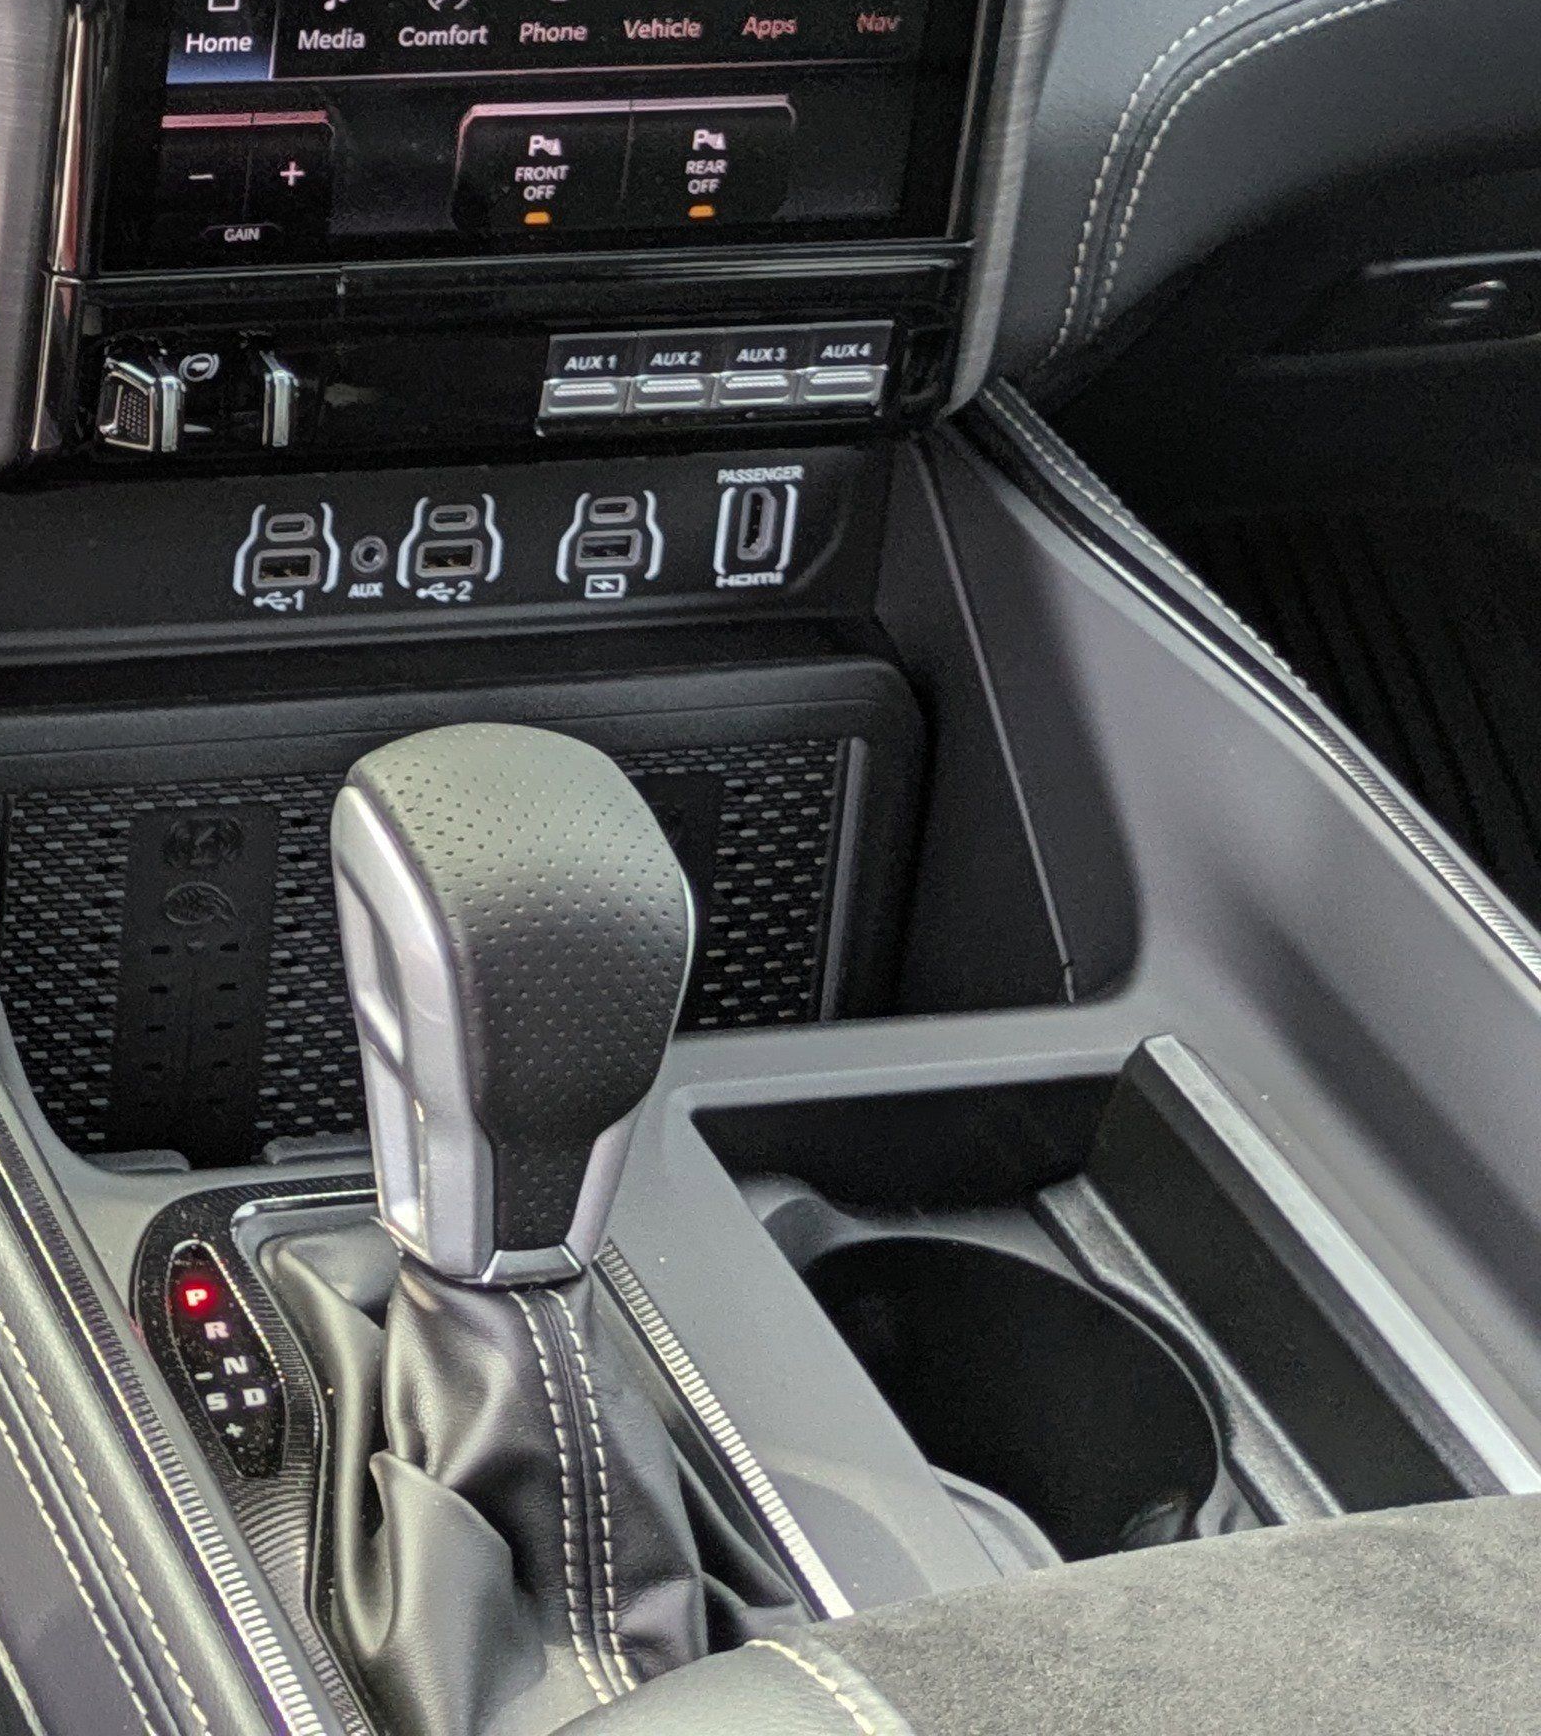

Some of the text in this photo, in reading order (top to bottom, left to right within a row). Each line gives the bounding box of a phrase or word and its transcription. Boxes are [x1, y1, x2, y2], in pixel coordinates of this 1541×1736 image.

[185, 33, 253, 54] Home
[297, 27, 366, 51] Media
[398, 24, 490, 48] Comfort
[519, 21, 589, 44] Phone
[623, 17, 704, 41] Vehicle
[741, 15, 798, 41] Apps
[514, 164, 570, 182] FRONT
[685, 159, 727, 176] REAR
[523, 184, 557, 202] OFF
[687, 177, 721, 195] OFF
[223, 226, 261, 243] GAIN
[649, 350, 703, 368] AUX 2
[735, 346, 788, 364] AUX 3
[820, 342, 872, 360] AUX 4
[563, 355, 604, 372] AUX
[716, 464, 804, 484] PASSENGER
[347, 582, 385, 599] AUX
[456, 581, 473, 603] 2
[184, 1287, 209, 1308] P
[203, 1320, 231, 1341] R
[222, 1355, 249, 1377] N
[204, 1392, 230, 1412] S
[241, 1386, 268, 1408] D
